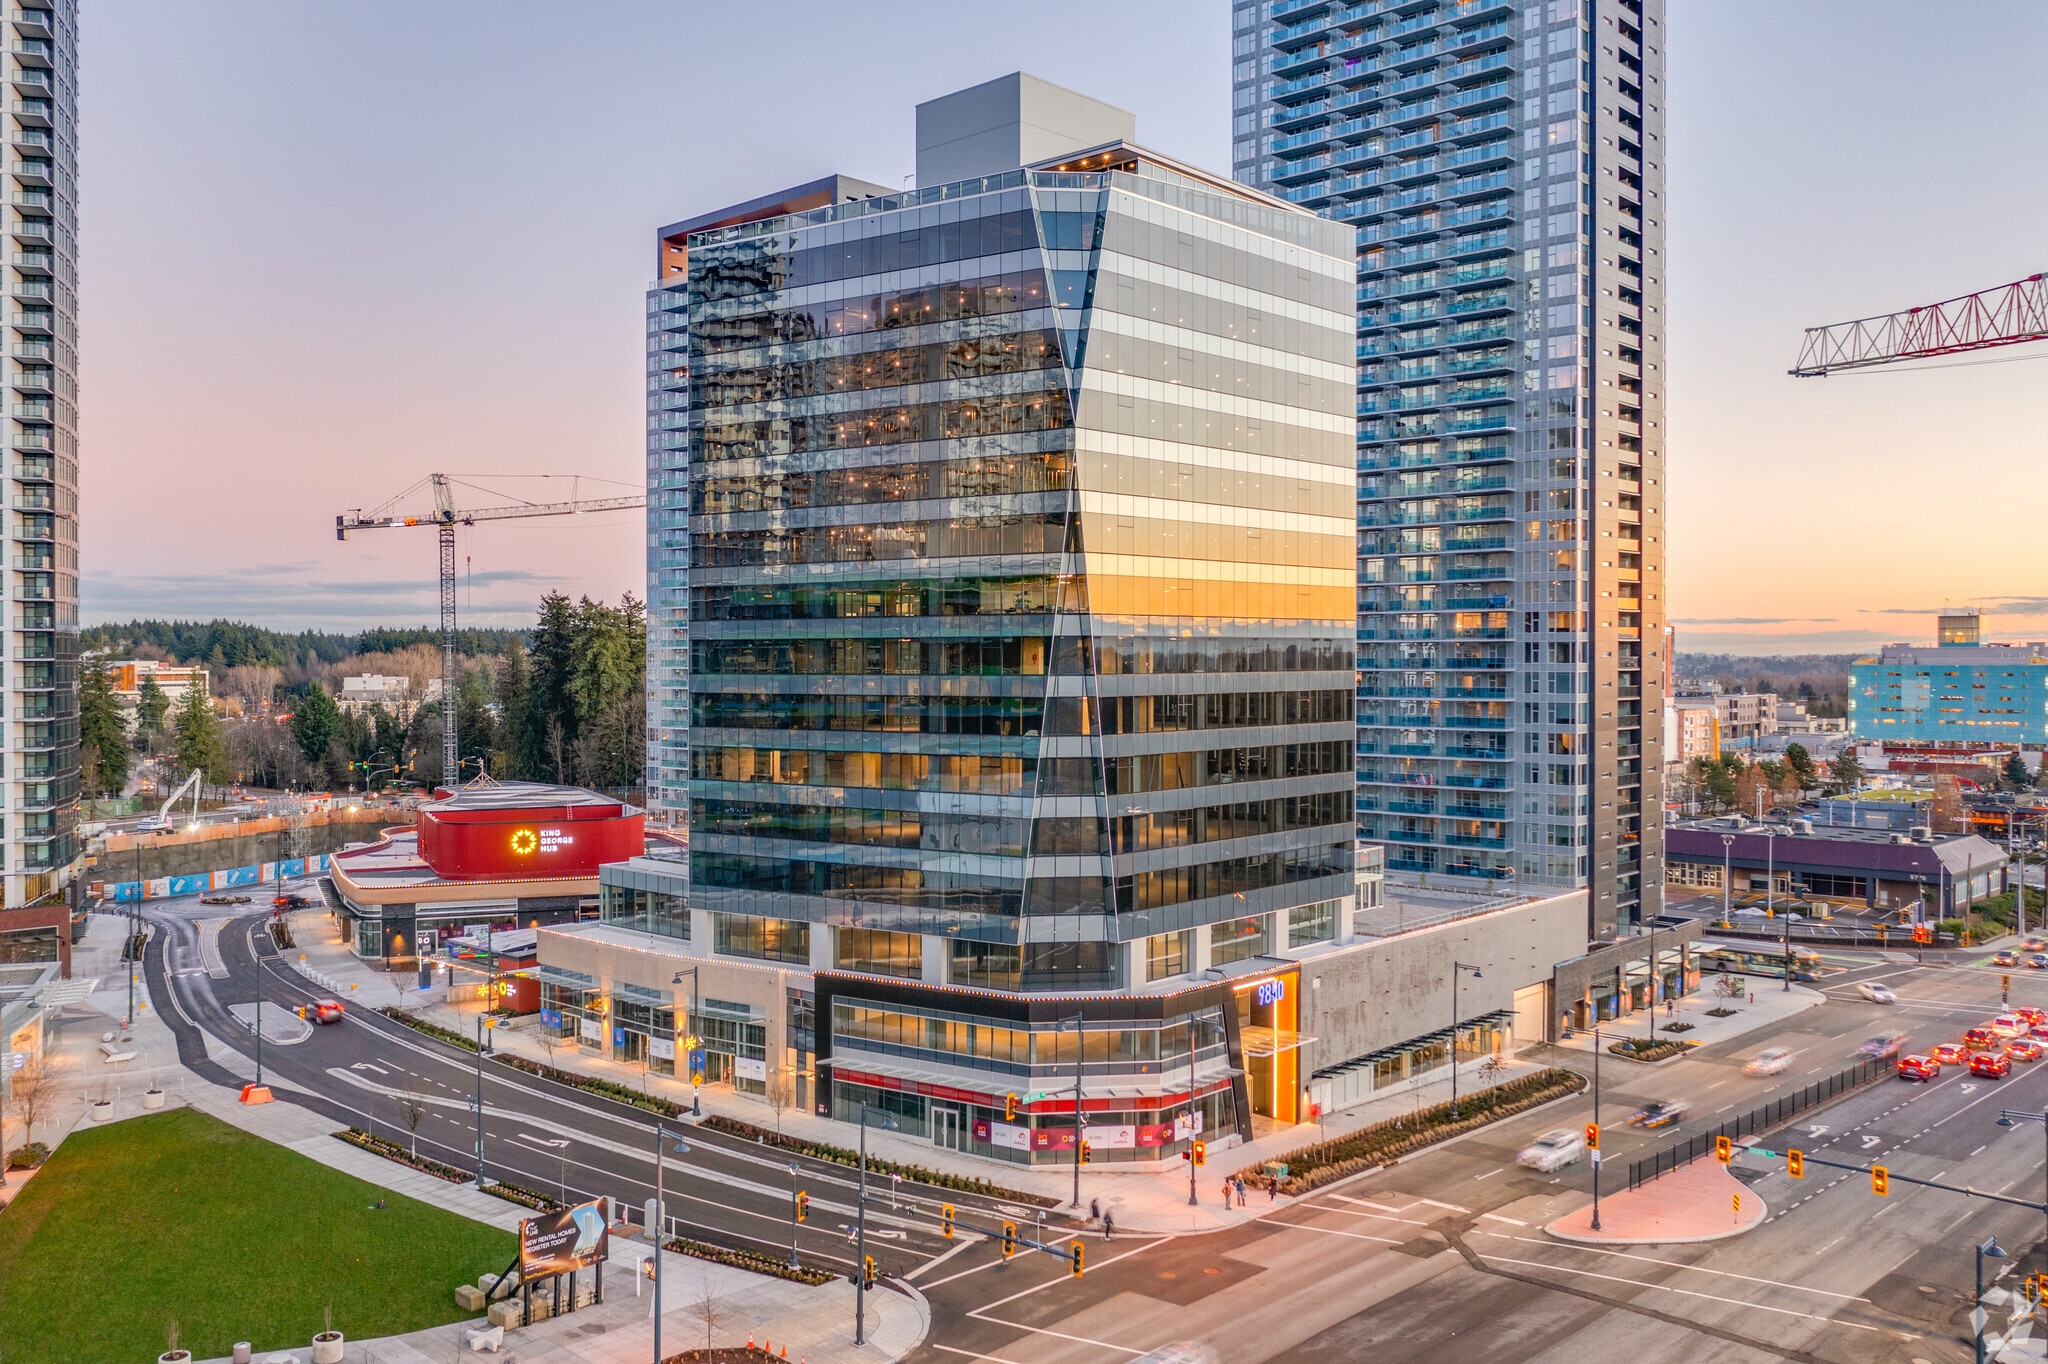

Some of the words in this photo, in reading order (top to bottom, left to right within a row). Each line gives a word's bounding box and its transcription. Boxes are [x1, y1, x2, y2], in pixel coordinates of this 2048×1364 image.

[541, 829, 561, 837] KING
[541, 837, 574, 845] GEORGE
[1259, 980, 1285, 1006] 9850
[525, 1237, 538, 1246] NEW
[538, 1233, 557, 1243] RENTAL
[557, 1227, 576, 1238] HOMES
[525, 1242, 550, 1253] REGISTER
[551, 1237, 568, 1247] TODAY
